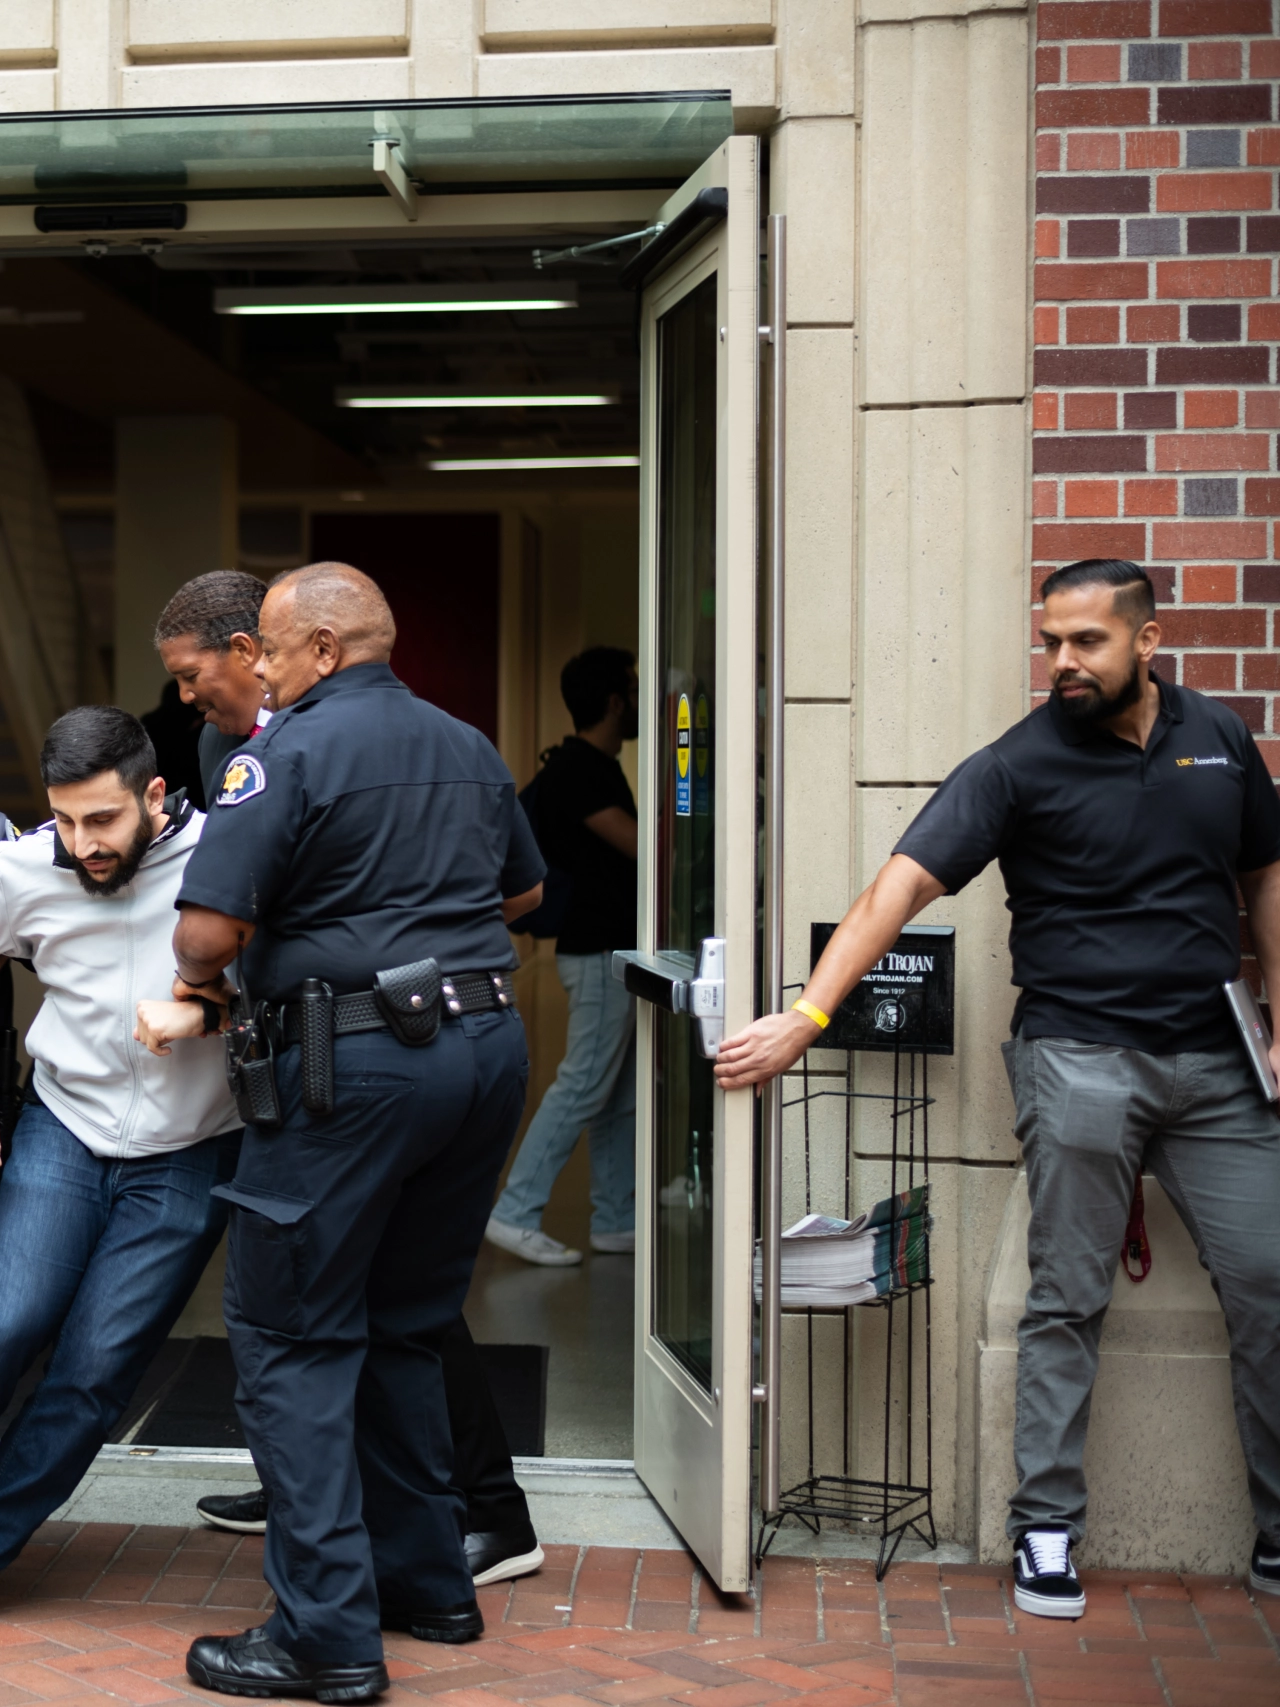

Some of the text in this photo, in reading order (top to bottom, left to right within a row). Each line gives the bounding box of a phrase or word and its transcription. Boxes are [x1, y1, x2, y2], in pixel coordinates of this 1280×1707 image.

[1175, 756, 1229, 767] USC Annenberg
[886, 952, 934, 974] TROJAN
[861, 974, 923, 983] AILYTROJAN.COM
